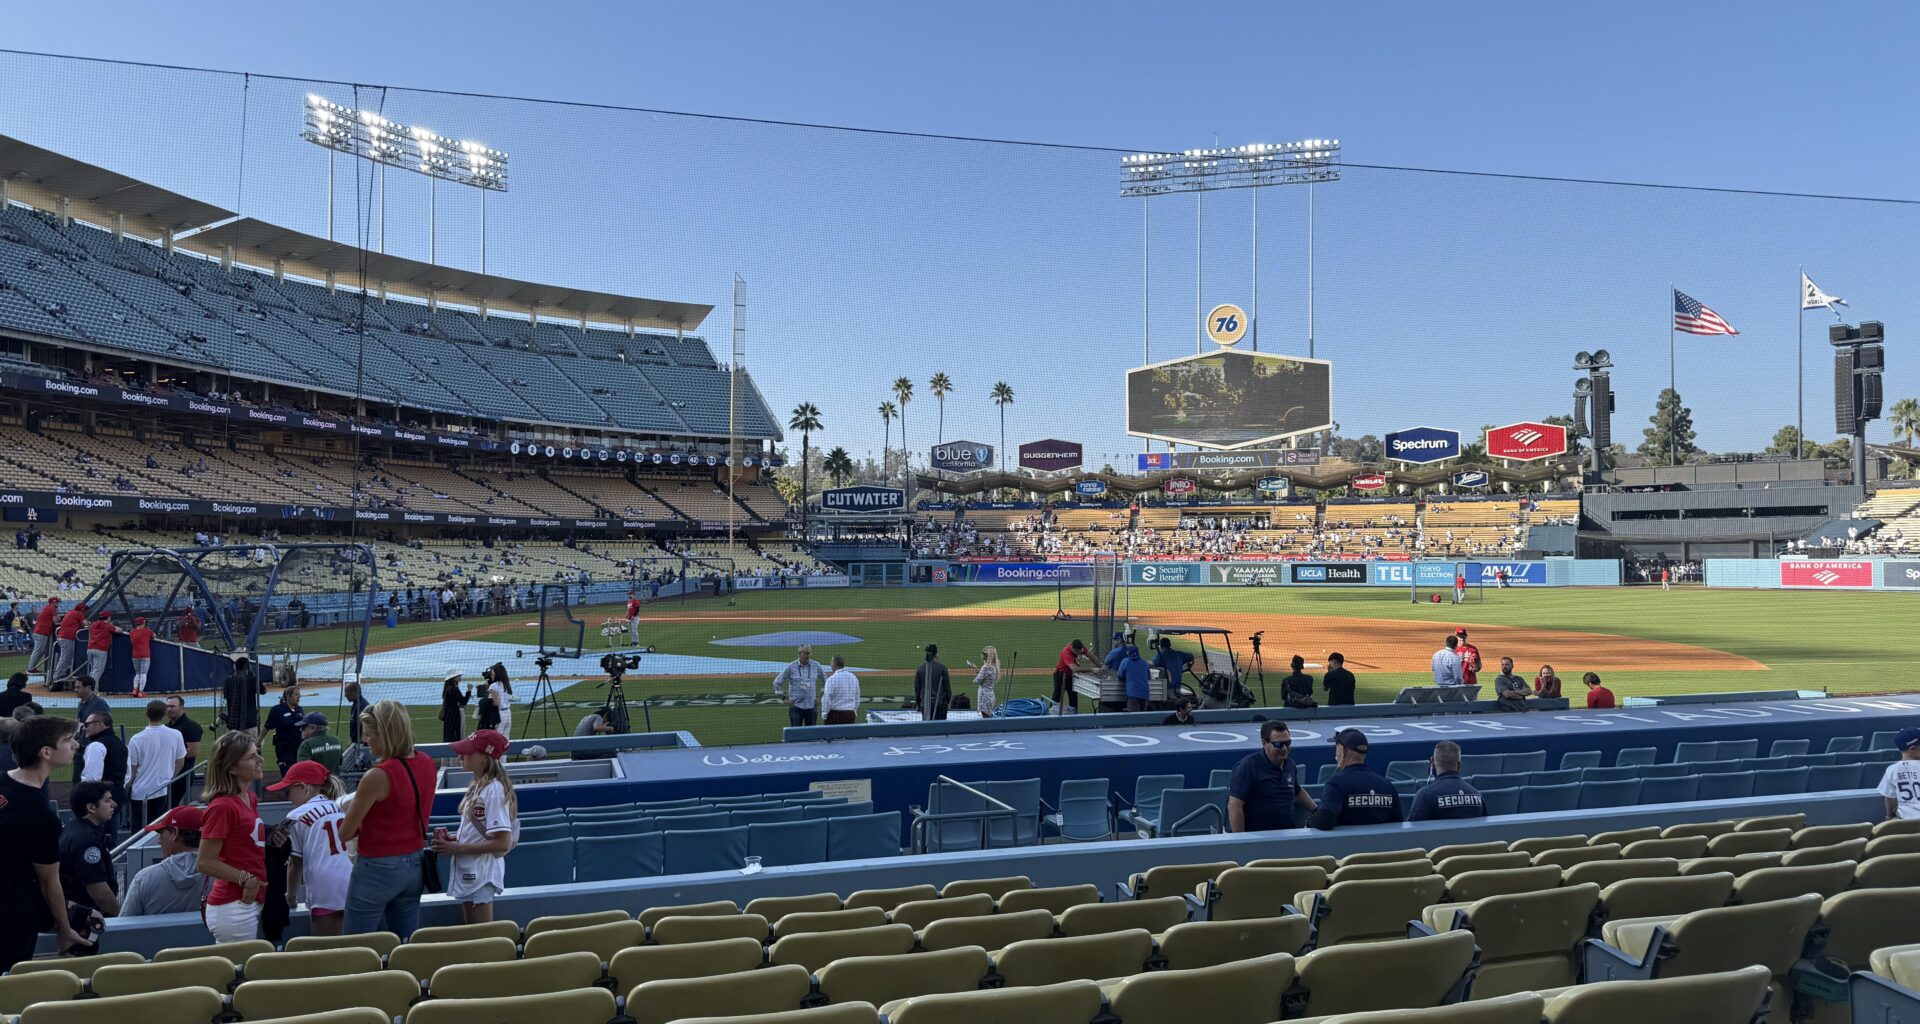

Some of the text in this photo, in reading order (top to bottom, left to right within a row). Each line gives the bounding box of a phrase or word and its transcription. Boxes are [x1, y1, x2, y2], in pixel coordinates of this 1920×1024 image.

[1215, 314, 1239, 333] 76
[45, 379, 98, 396] Booking.com
[122, 390, 168, 406] Booking.com
[189, 400, 230, 414] Booking.com
[249, 410, 286, 422] Booking.com
[302, 417, 336, 428] Booking.com
[1392, 439, 1448, 452] Spectrum
[936, 448, 972, 461] blue
[1200, 455, 1254, 464] Booking.com
[1170, 480, 1190, 490] JINRO
[56, 496, 112, 508] Booking.com
[827, 492, 898, 506] CUTWATER
[139, 500, 190, 512] Booking.com
[28, 508, 38, 520] LA
[356, 510, 390, 520] Booking.com
[404, 512, 434, 522] Booking.com
[448, 514, 476, 524] Booking.com
[488, 517, 516, 526] Booking.com
[530, 518, 560, 526] Booking.com
[576, 520, 608, 528] Booking.com
[998, 568, 1070, 578] Booking.com
[1158, 566, 1188, 575] Security
[1328, 568, 1360, 578] Health
[1377, 566, 1412, 580] TEL
[1482, 566, 1513, 576] ANA
[1158, 573, 1184, 581] Benefit
[1097, 700, 1920, 748] DODGER STADIUM
[702, 752, 845, 766] Welcome
[1897, 771, 1918, 780] BETTS
[1348, 794, 1393, 806] SECURITY
[1438, 794, 1482, 806] SECURITY
